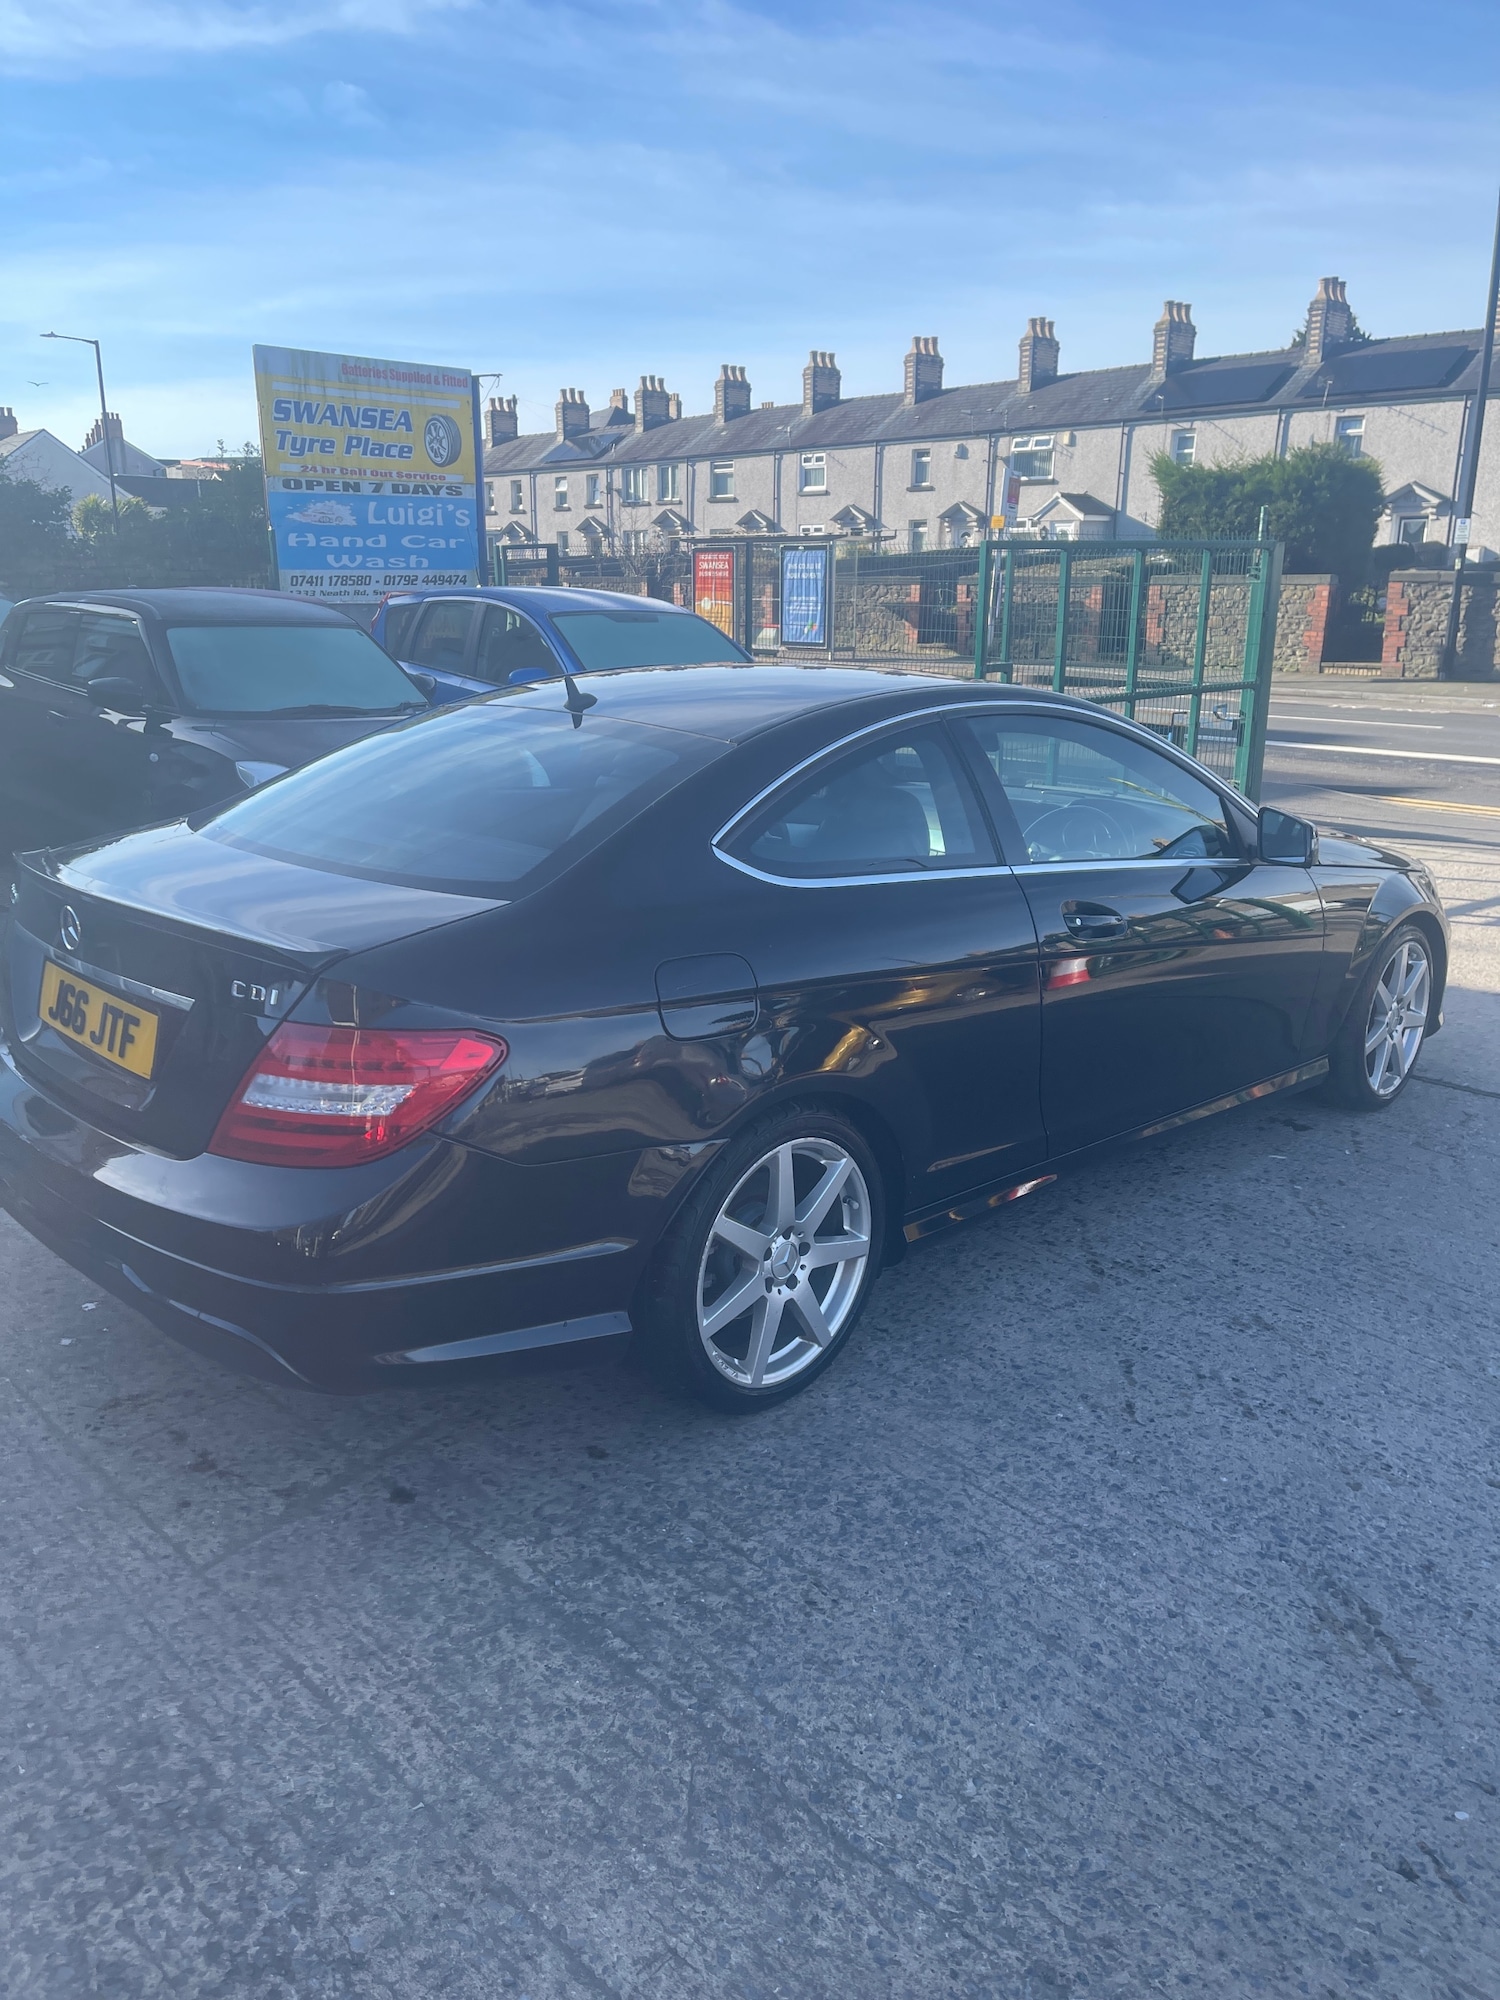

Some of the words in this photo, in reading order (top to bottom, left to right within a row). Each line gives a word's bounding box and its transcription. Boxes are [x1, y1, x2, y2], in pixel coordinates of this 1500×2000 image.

[341, 362, 388, 380] Batteries
[389, 368, 432, 385] Supplied
[433, 374, 440, 386] &
[442, 375, 469, 389] Fitted
[273, 399, 414, 433] SWANSEA
[275, 429, 337, 458] Tyre
[343, 434, 414, 461] Place
[300, 464, 319, 474] 24
[320, 465, 338, 475] hr
[339, 466, 368, 477] Call
[369, 469, 394, 479] Out
[395, 470, 447, 481] Service
[282, 478, 361, 493] OPEN
[368, 482, 384, 493] 7
[391, 482, 463, 496] DAYS
[367, 501, 471, 527] Luigi's
[287, 532, 387, 548] Hand
[400, 534, 465, 549] Car
[326, 553, 429, 568] Wash
[698, 561, 729, 569] SWANSEA
[290, 575, 324, 587] 07411
[328, 575, 372, 587] 178580
[383, 574, 418, 586] 01792
[421, 574, 468, 586] 449474
[319, 589, 350, 597] Neath
[353, 589, 369, 597] Rd,
[231, 980, 279, 1005] CDI
[48, 979, 89, 1035] J66
[89, 1002, 140, 1059] JTF
